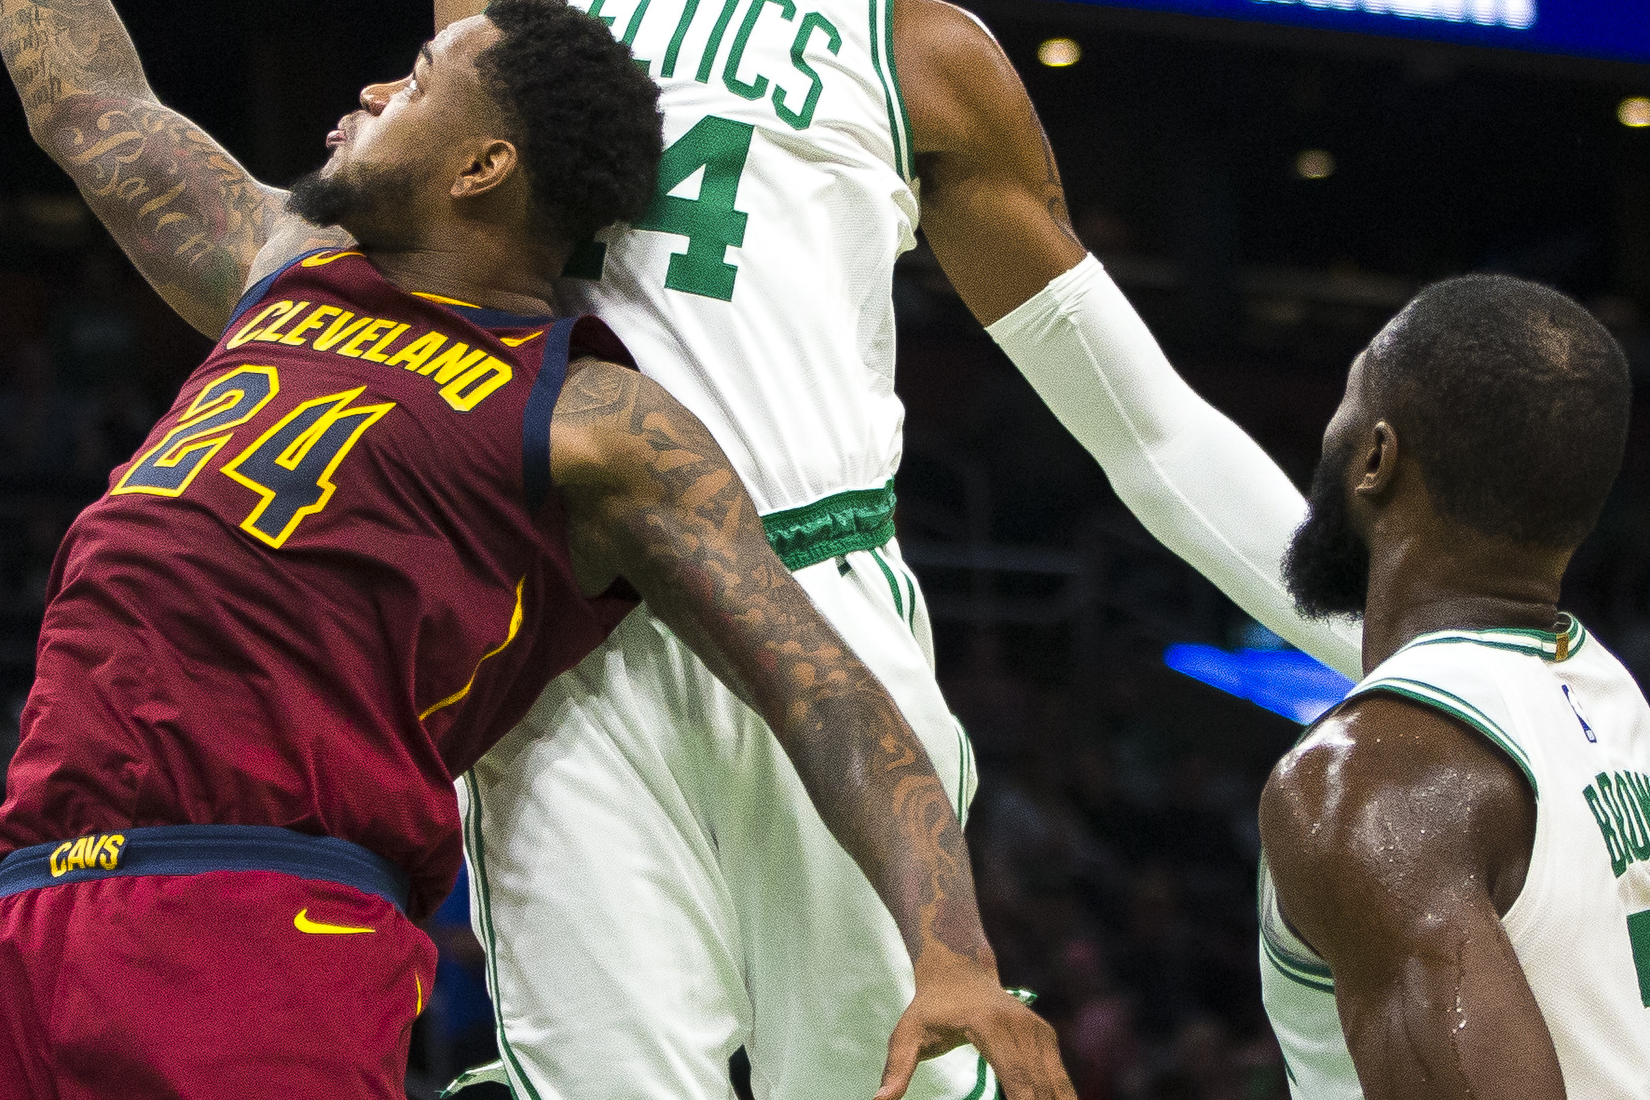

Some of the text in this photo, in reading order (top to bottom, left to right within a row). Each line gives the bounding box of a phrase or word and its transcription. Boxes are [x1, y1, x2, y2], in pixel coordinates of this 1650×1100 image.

[226, 300, 514, 413] CLEVELAND
[109, 363, 398, 550] 24
[49, 834, 125, 878] CAVS
